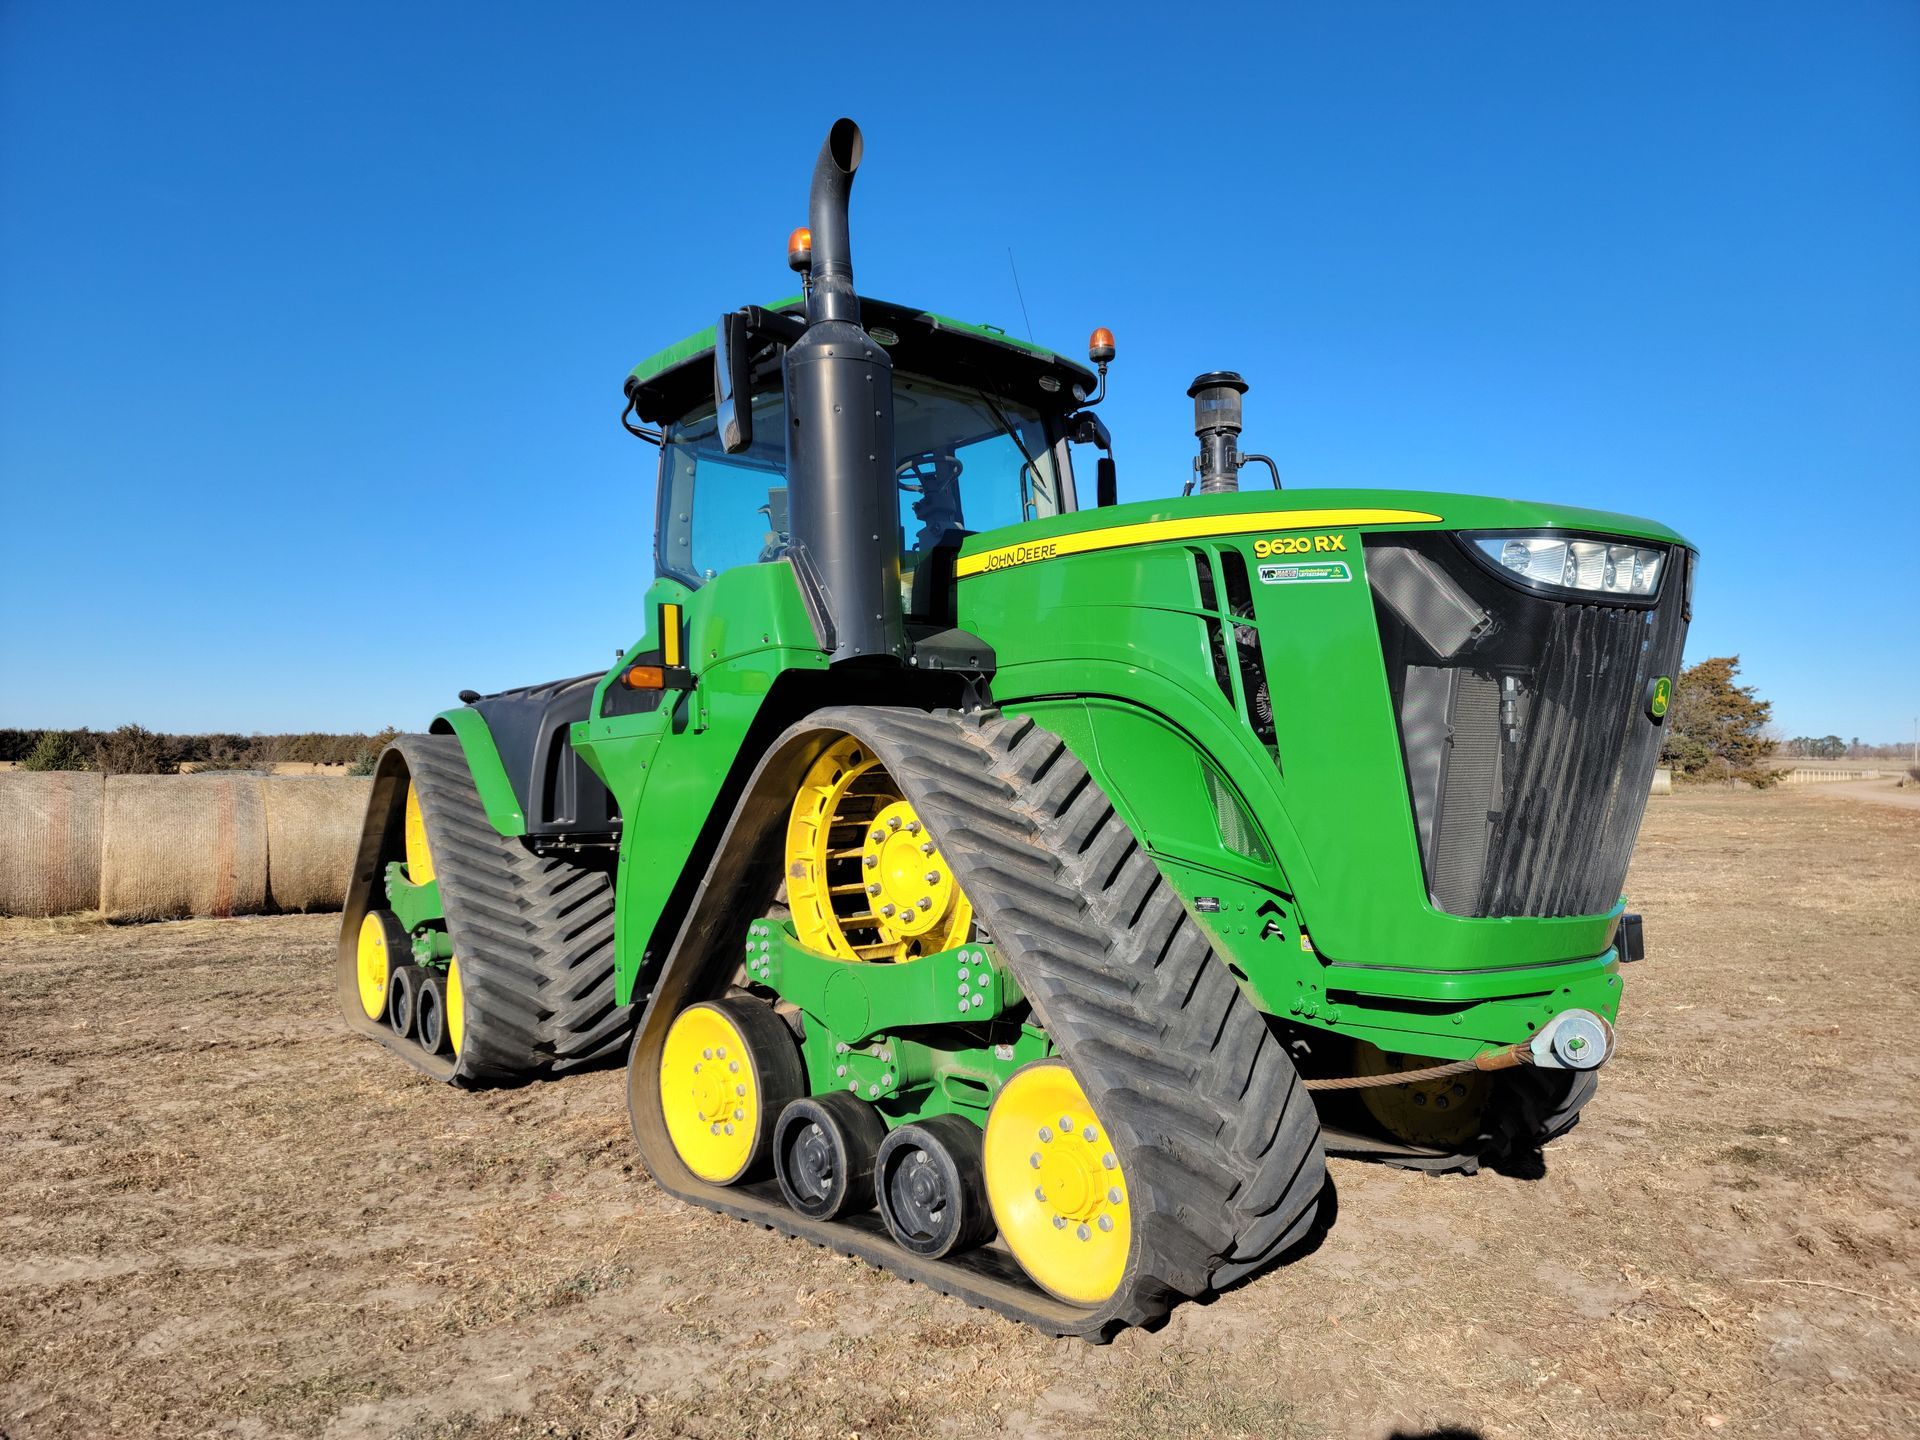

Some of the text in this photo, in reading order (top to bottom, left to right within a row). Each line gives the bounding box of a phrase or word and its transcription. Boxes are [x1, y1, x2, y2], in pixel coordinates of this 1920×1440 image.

[984, 543, 1057, 570] JOHN DEERE
[1253, 534, 1347, 559] 9620 RX
